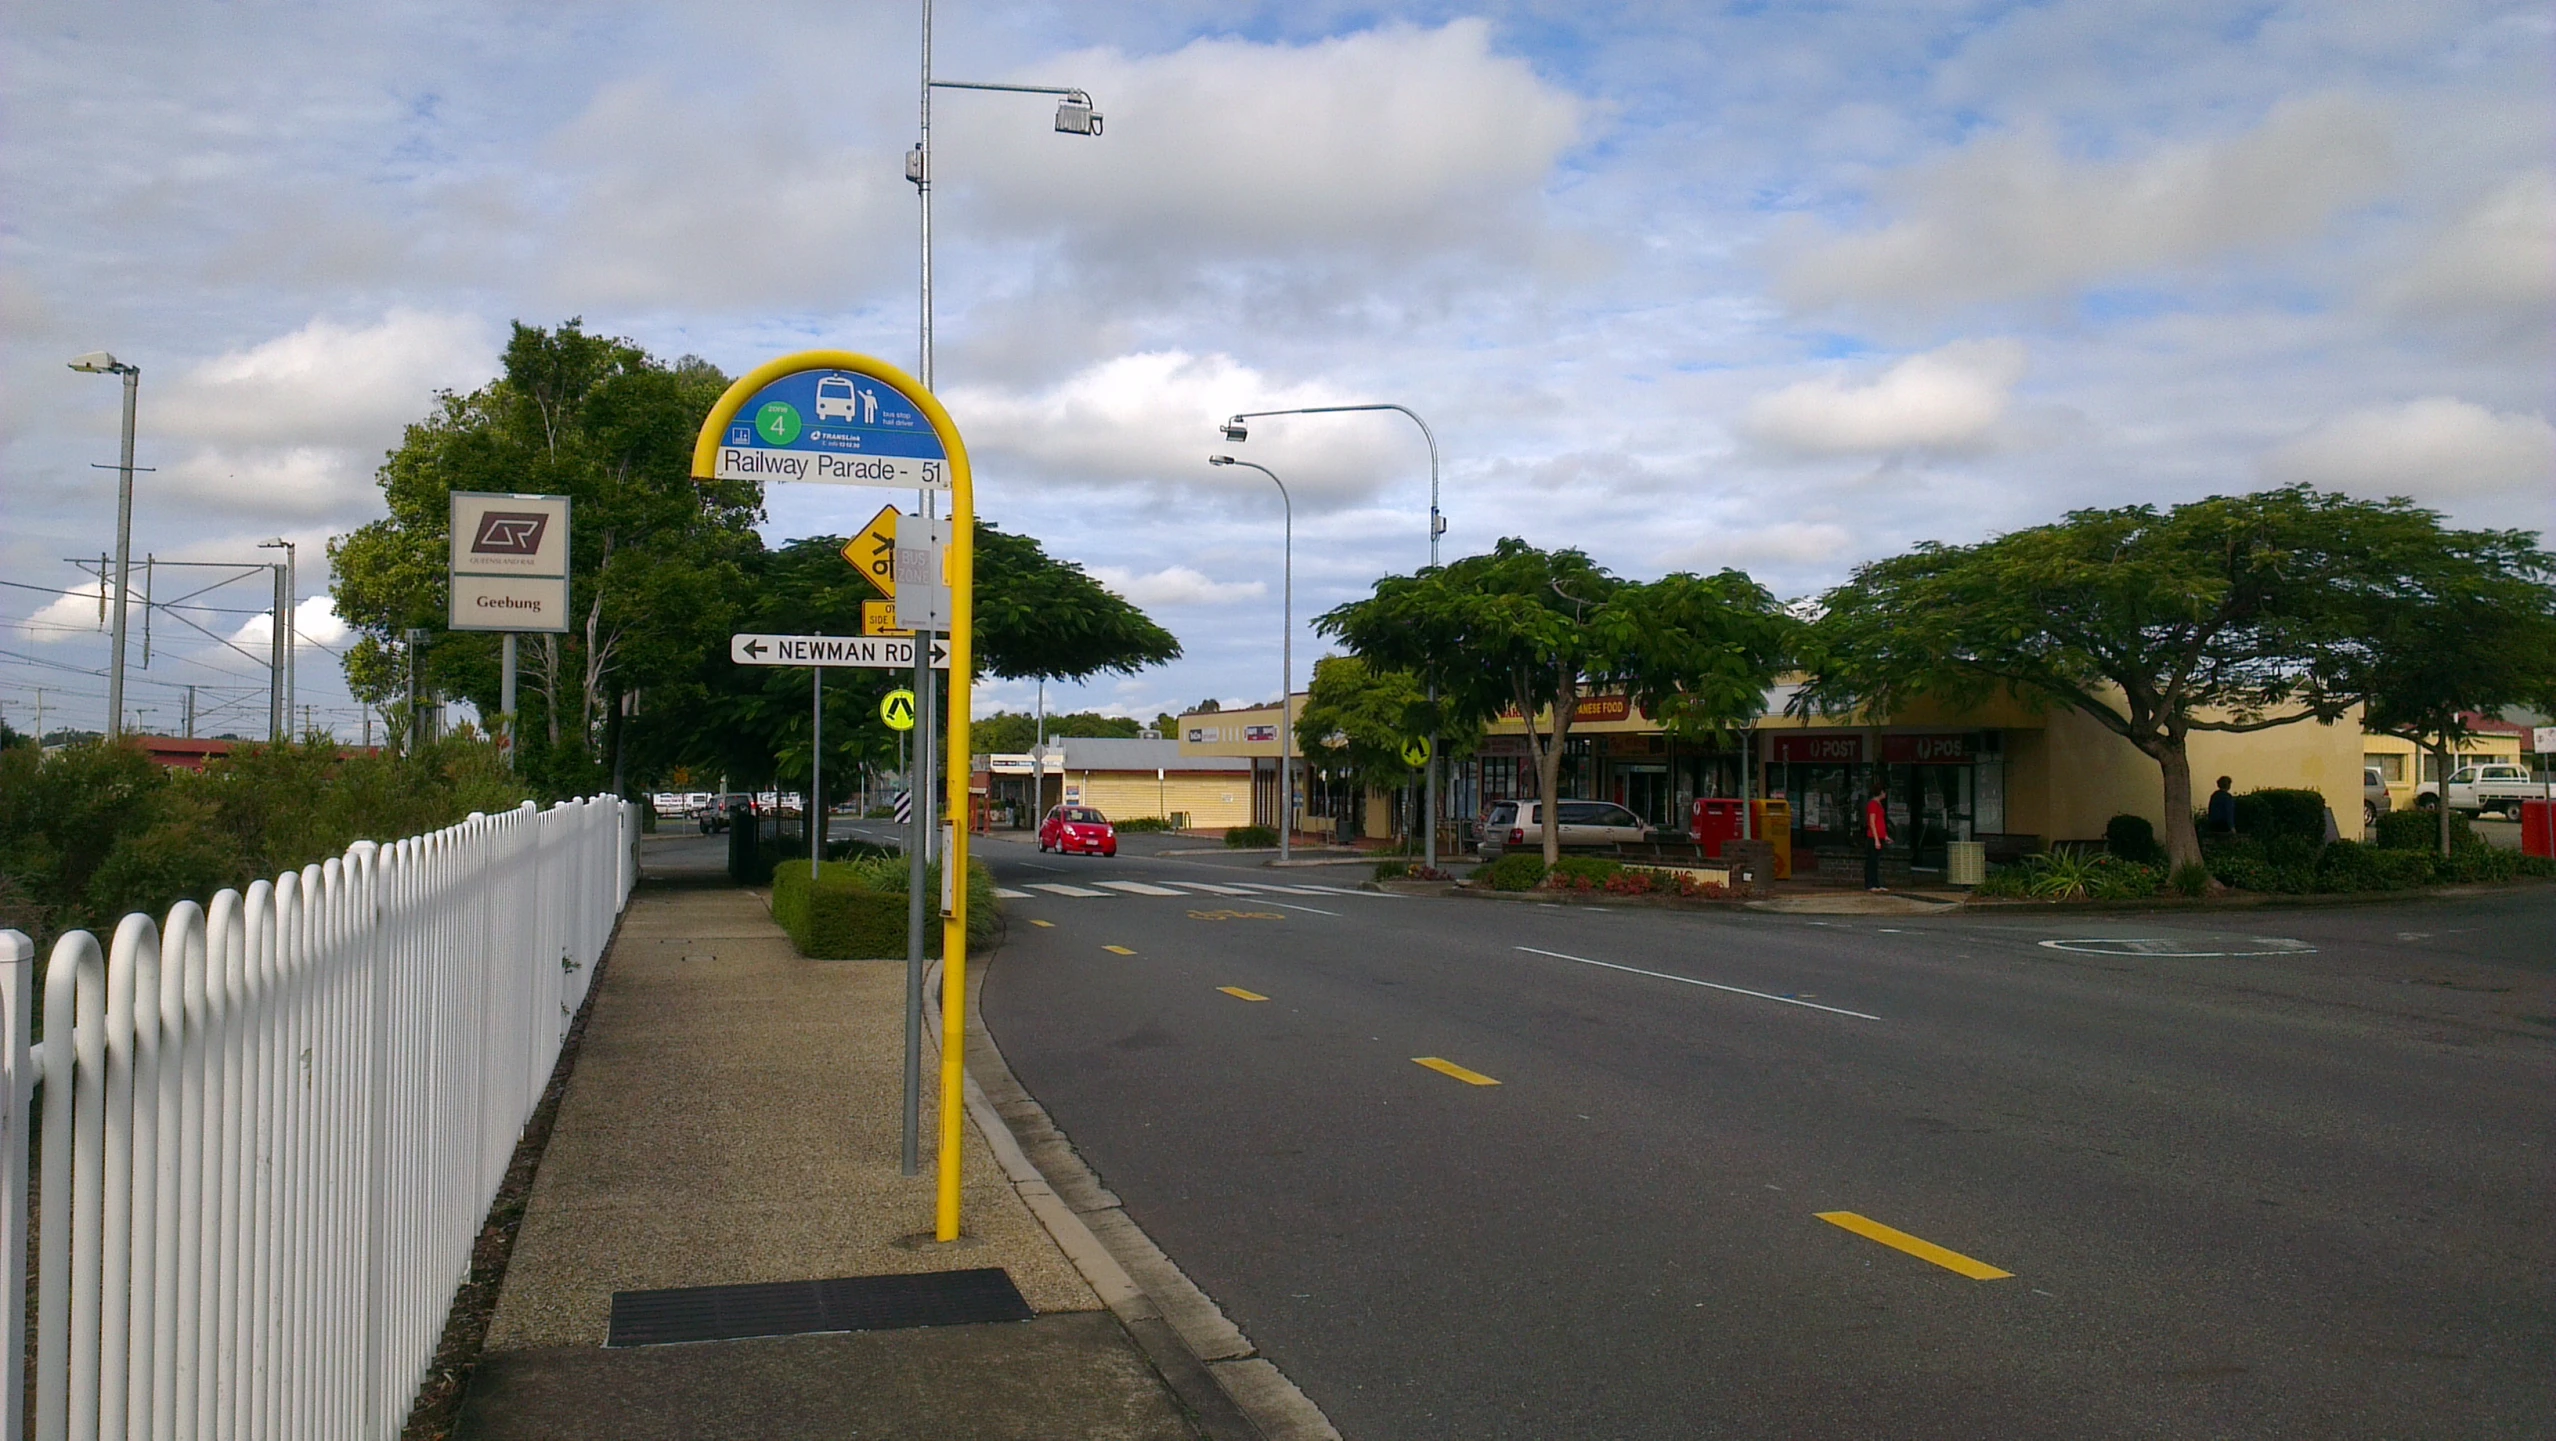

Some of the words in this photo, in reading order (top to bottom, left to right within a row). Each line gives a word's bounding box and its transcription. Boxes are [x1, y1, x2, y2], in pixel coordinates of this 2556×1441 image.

[882, 410, 895, 418] bus
[896, 412, 911, 420] stop
[895, 419, 914, 427] driver
[769, 415, 785, 436] 4
[725, 449, 808, 480] Railway
[921, 461, 941, 483] 51
[902, 551, 926, 566] BUS
[897, 567, 930, 584] ZONE
[476, 595, 541, 612] Geebung
[869, 615, 889, 625] SIDE
[779, 640, 875, 661] NEWMAN
[885, 643, 913, 662] RD
[1574, 702, 1602, 715] ANESE
[1602, 701, 1624, 714] FOOD
[1822, 739, 1857, 757] POST
[1933, 739, 1962, 757] POS
